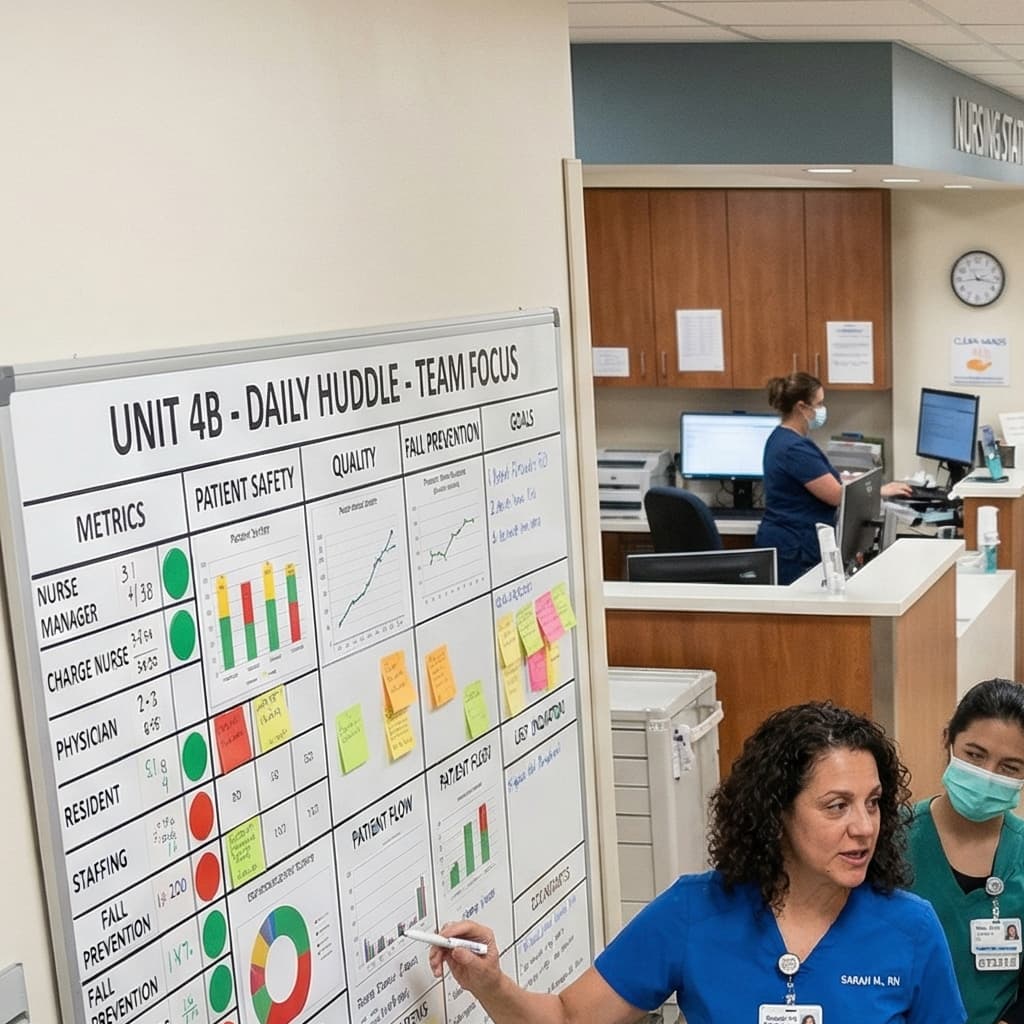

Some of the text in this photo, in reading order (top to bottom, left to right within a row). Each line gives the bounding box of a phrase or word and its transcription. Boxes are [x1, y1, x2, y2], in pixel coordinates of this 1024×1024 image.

[955, 96, 1000, 160] NURSING
[110, 345, 519, 455] UNIT 4B - DAILY HUDDLE - TEAM FOCUS
[510, 409, 535, 431] GOALS
[405, 422, 480, 458] FALL PREVENTION
[332, 446, 376, 478] QUALITY
[195, 465, 295, 513] PATIENT SAFETY
[76, 501, 147, 544] METRICS
[37, 577, 79, 606] NURSE
[41, 603, 98, 639] MANAGER
[47, 660, 92, 692] CHARGE
[95, 646, 130, 674] NURSE
[56, 718, 118, 761] PHYSICIAN
[64, 784, 121, 828] RESIDENT
[352, 794, 413, 850] PATIENT FLOW
[72, 848, 128, 894] STAFFING
[100, 900, 129, 930] FALL
[83, 914, 152, 971] PREVENTION
[88, 976, 116, 1008] FALL
[887, 975, 900, 986] RN
